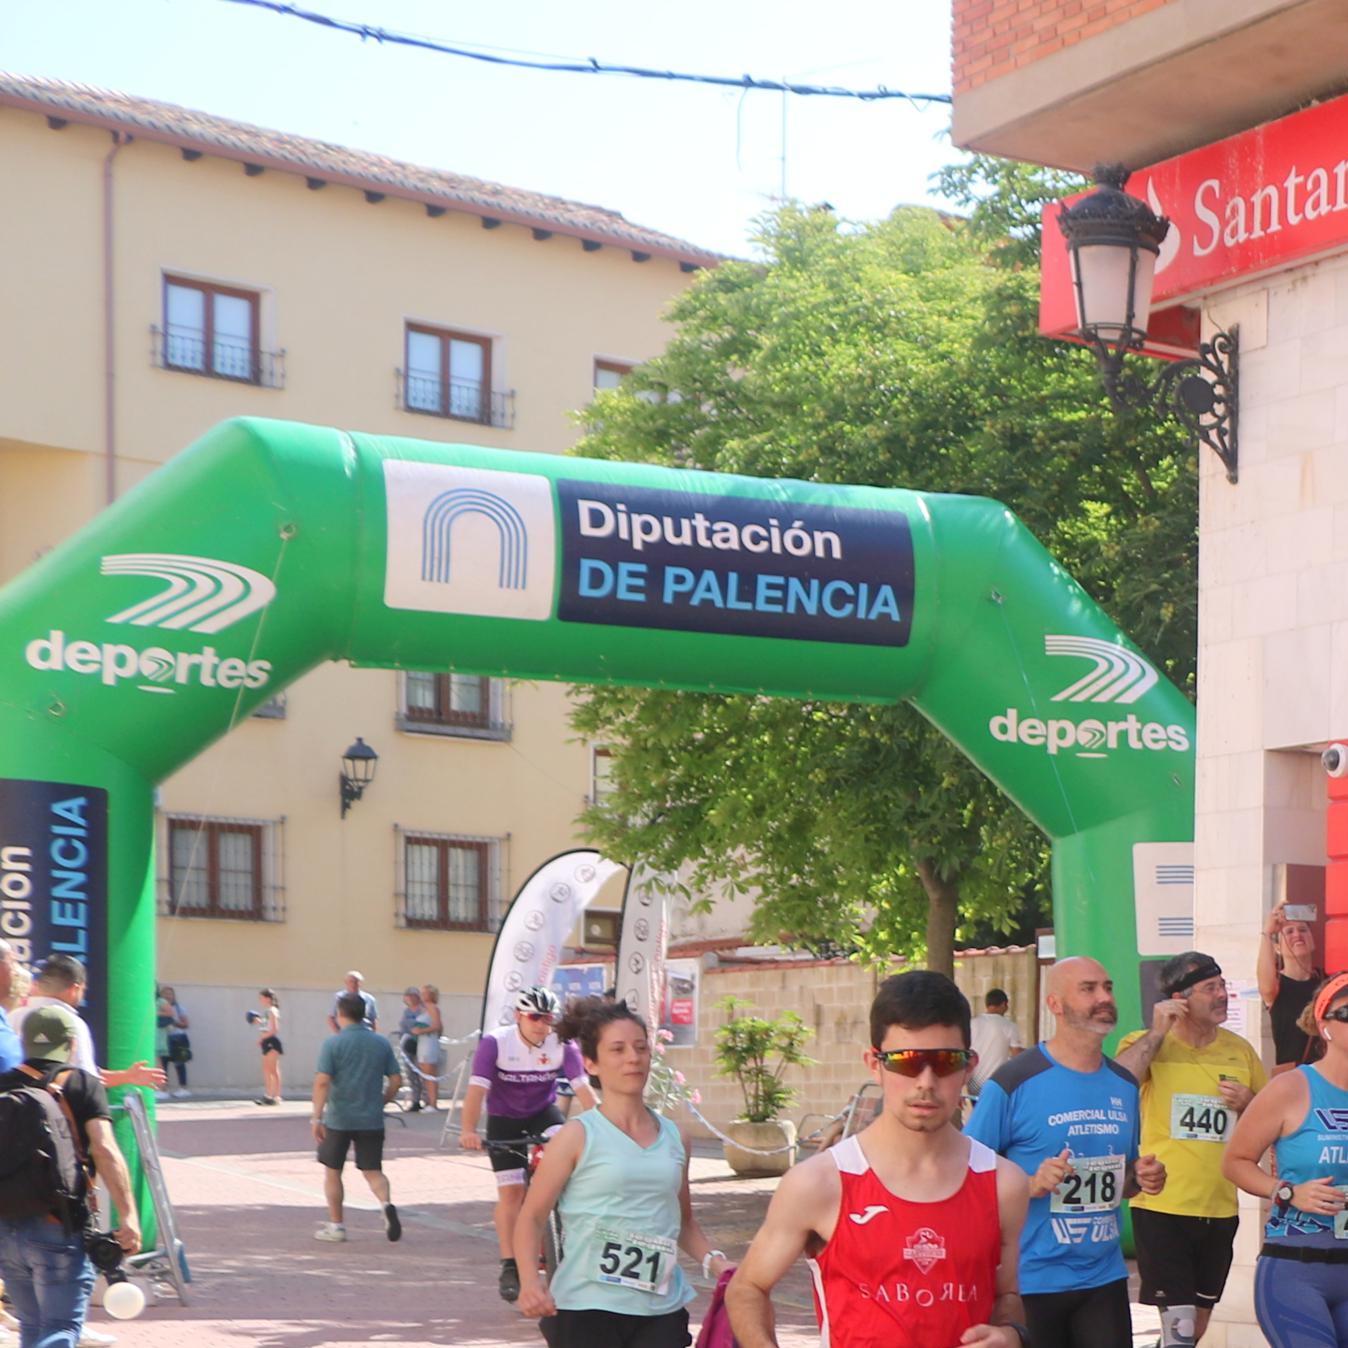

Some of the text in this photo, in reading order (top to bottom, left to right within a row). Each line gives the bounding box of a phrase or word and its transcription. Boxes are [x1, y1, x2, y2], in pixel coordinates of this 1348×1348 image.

[579, 499, 841, 560] Diputación
[578, 558, 901, 622] DE PALENCIA
[26, 629, 272, 690] deportes
[989, 707, 1190, 755] deportes
[50, 796, 88, 962] LENCIA
[1048, 1109, 1106, 1126] COMERCIAL
[1067, 1124, 1120, 1137] ATLETISMO
[1180, 1106, 1228, 1135] 440
[1062, 1172, 1116, 1205] 218
[599, 1242, 661, 1283] 521
